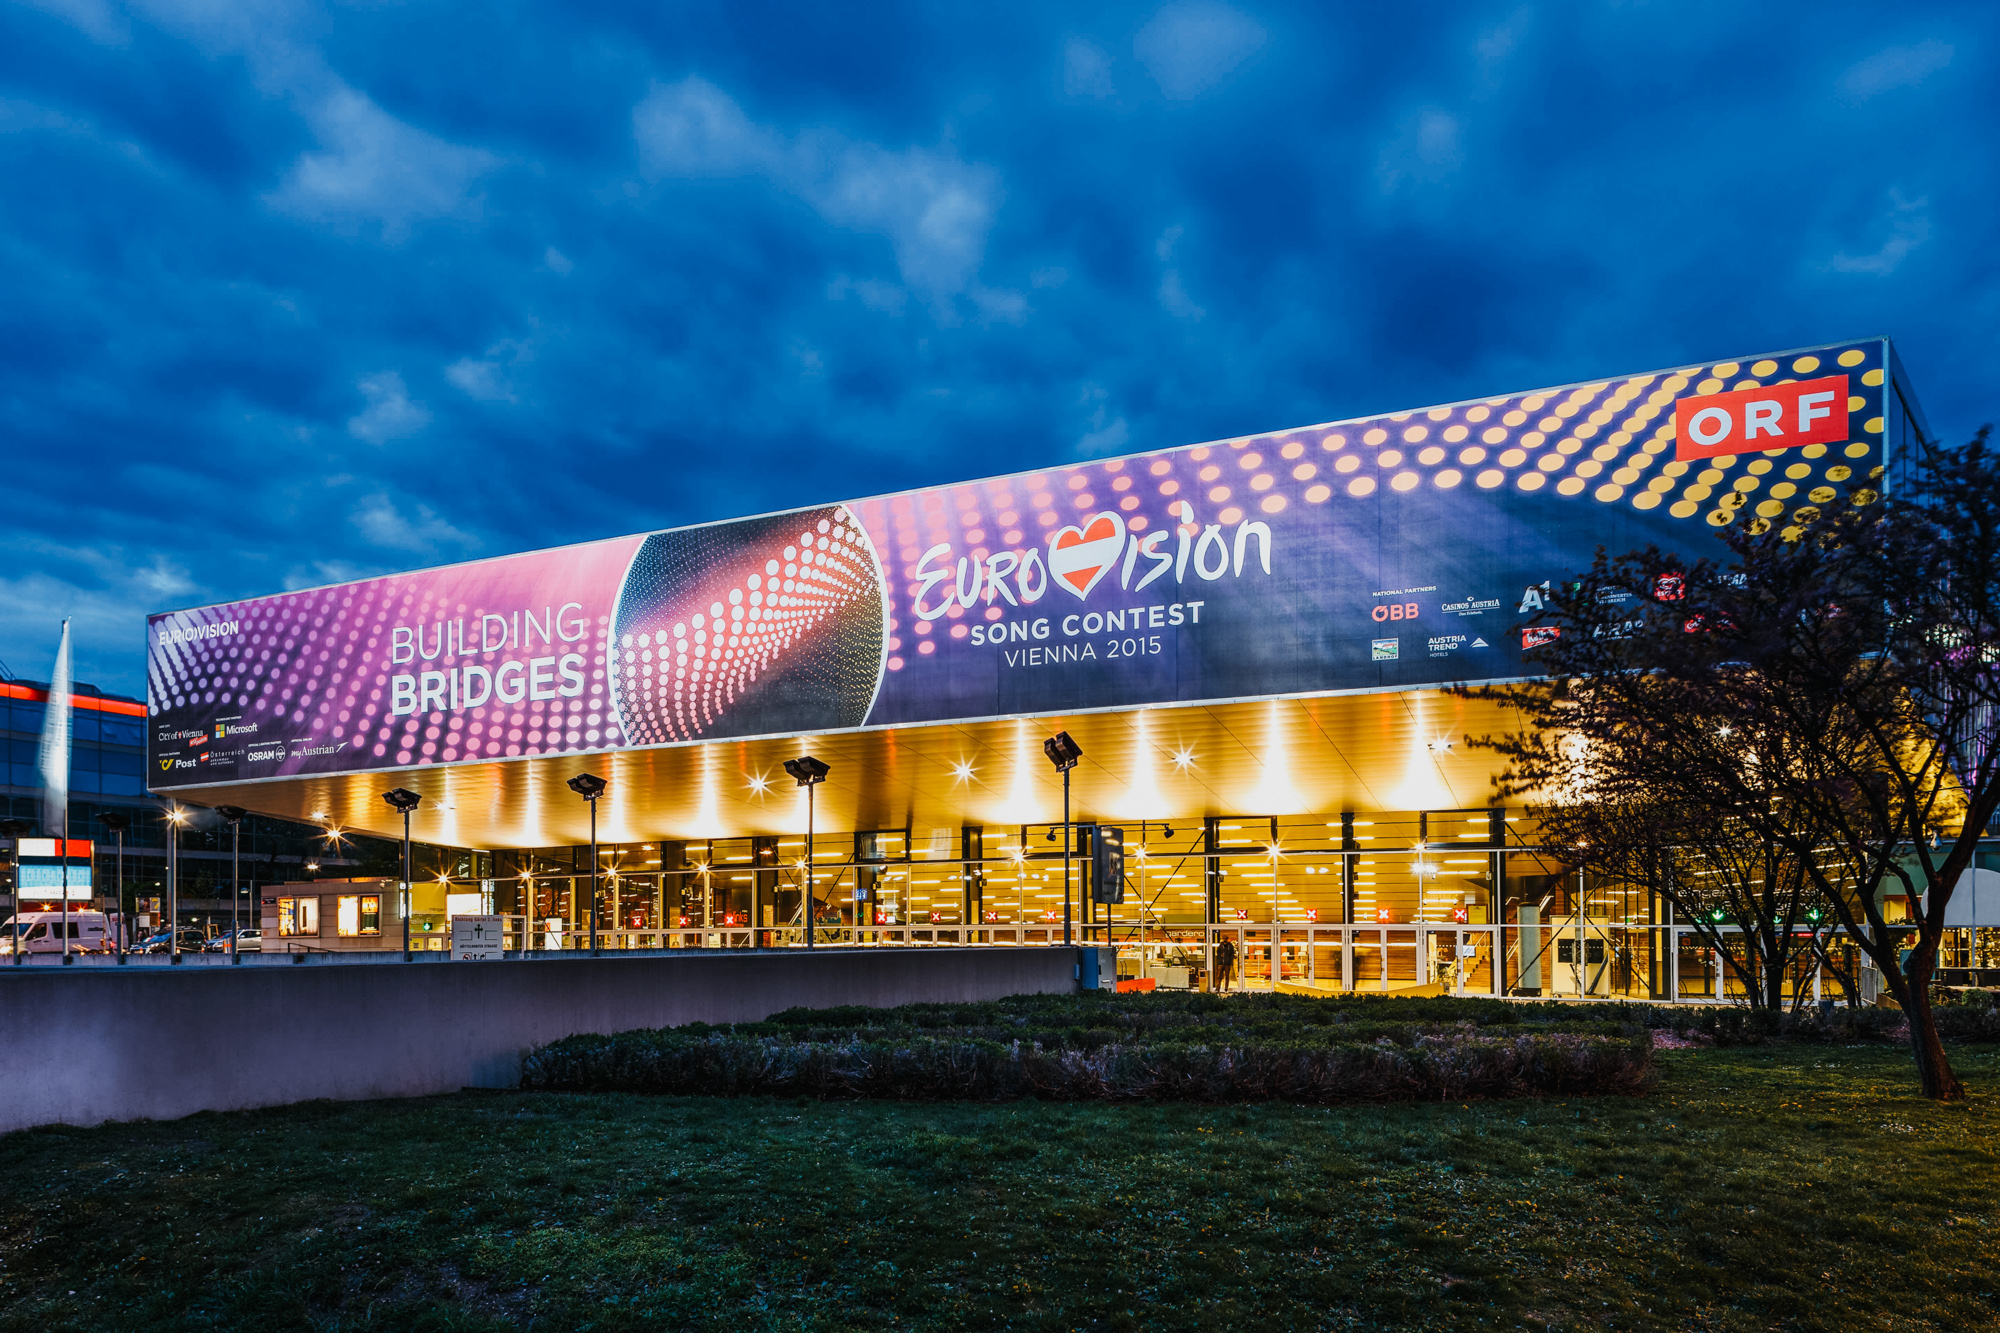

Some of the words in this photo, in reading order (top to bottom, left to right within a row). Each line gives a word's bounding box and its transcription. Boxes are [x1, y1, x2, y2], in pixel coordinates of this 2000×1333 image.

[1688, 390, 1835, 446] ORF
[1372, 589, 1403, 597] NATIONAL
[1404, 586, 1437, 594] PARTNERS
[1441, 600, 1470, 612] CASINOS
[1471, 598, 1500, 609] AUSTRIA
[1371, 602, 1419, 622] ÖBB
[970, 618, 1050, 646] SONG
[1062, 600, 1205, 636] CONTEST
[392, 602, 585, 665] BUILDING
[1428, 635, 1467, 645] AUSTRIA
[1004, 642, 1098, 668] VIENNA
[1106, 635, 1162, 658] 2015
[1428, 643, 1458, 652] TREND
[391, 653, 585, 716] BRIDGES
[181, 729, 204, 739] Vienna
[226, 722, 258, 735] Microsoft
[210, 749, 245, 758] Österreich
[247, 750, 275, 762] OSRAM
[175, 758, 197, 769] Post
